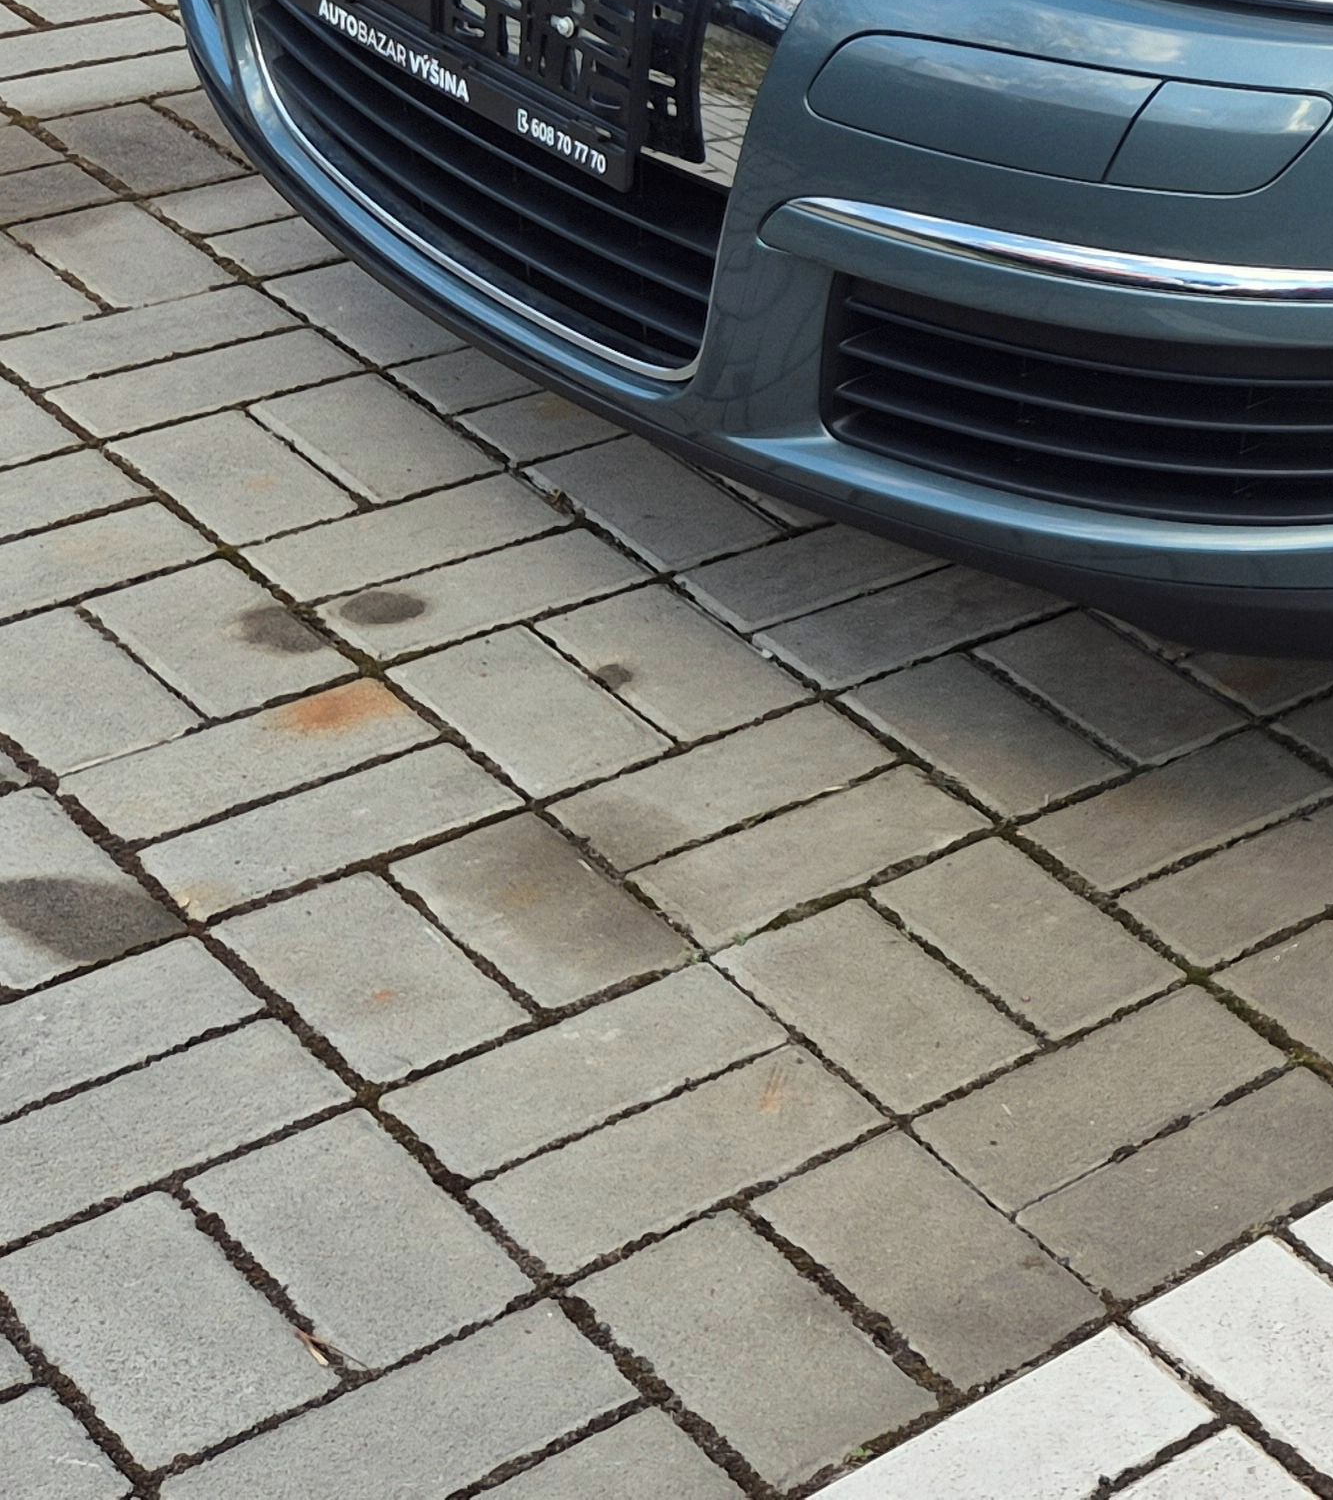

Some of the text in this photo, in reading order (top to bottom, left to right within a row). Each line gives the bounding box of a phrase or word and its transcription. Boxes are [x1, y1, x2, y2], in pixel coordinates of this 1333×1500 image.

[408, 50, 470, 103] VÝŠINA
[531, 118, 607, 175] 608 70 77 70
